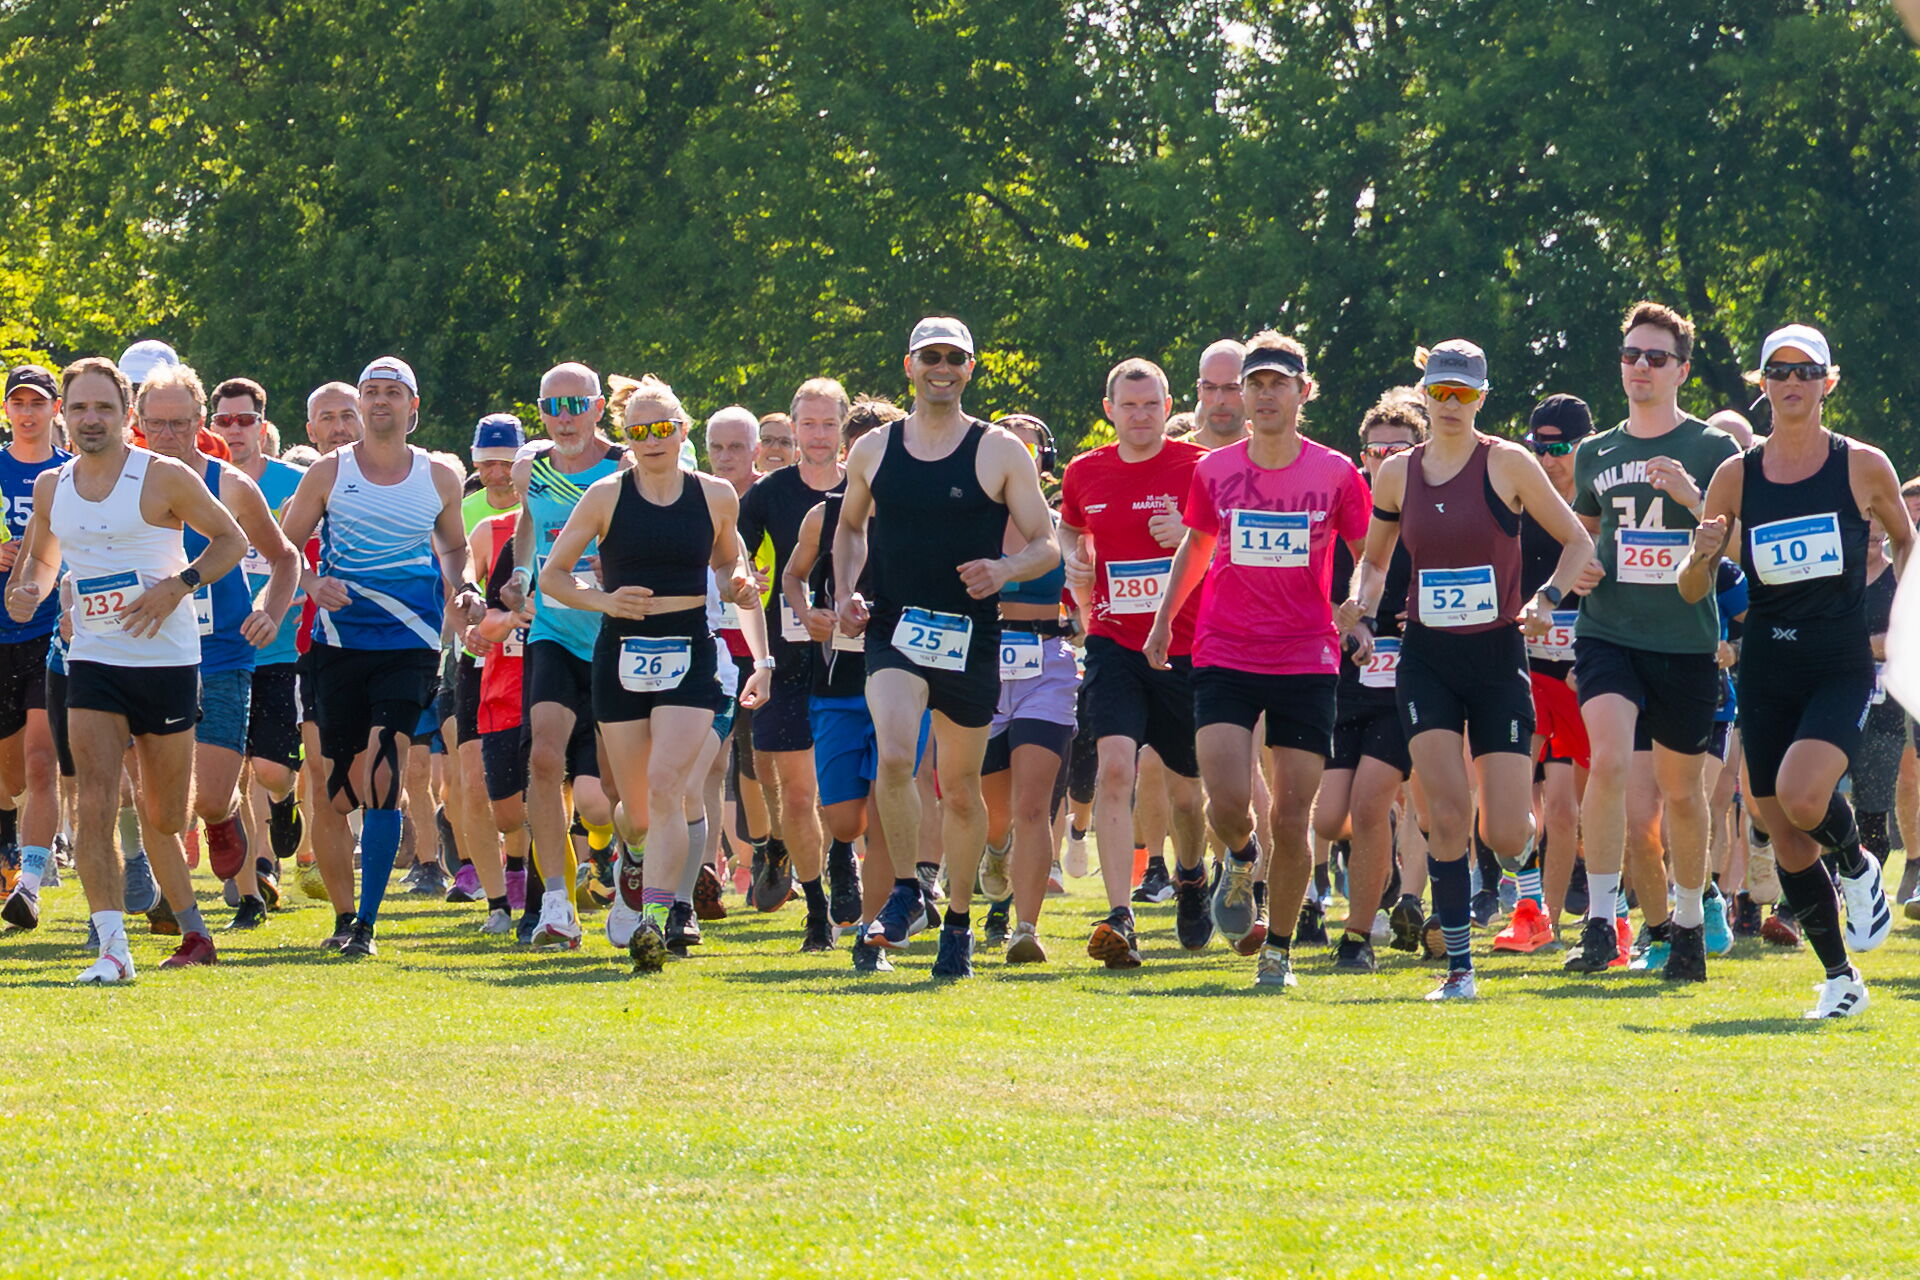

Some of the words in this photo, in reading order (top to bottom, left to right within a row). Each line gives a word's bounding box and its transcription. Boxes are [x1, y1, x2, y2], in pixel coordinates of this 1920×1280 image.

[1132, 501, 1178, 510] MARATHN
[1241, 530, 1291, 550] 114
[1624, 547, 1672, 567] 266
[1771, 540, 1807, 566] 10
[1114, 578, 1158, 598] 280
[83, 592, 127, 616] 232
[1433, 588, 1466, 609] 52
[908, 627, 943, 650] 25
[633, 656, 662, 675] 26
[1002, 647, 1016, 664] 0
[1367, 654, 1396, 673] 22
